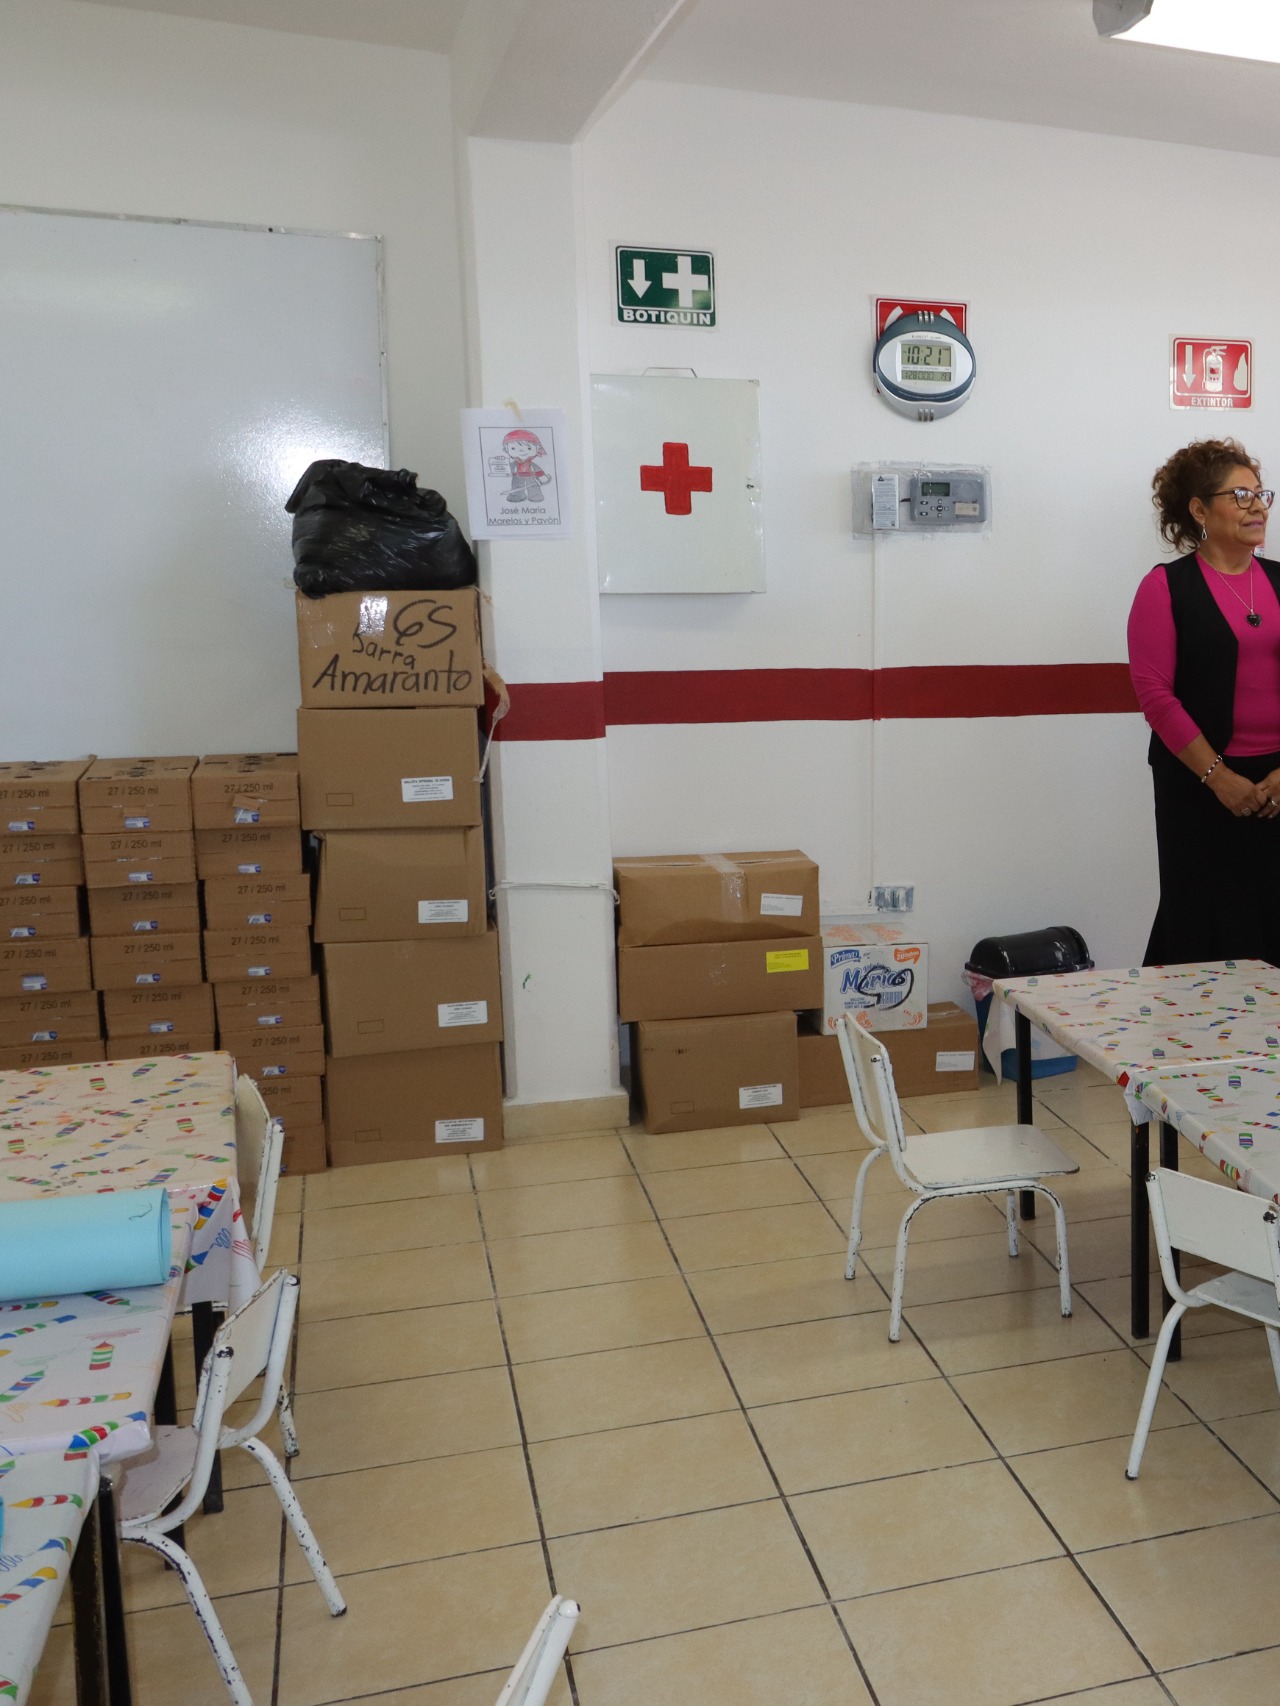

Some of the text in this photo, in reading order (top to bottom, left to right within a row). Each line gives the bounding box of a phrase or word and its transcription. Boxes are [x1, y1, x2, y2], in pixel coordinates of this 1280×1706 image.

[622, 308, 711, 325] BOTIQUIN
[907, 345, 942, 365] 10:21
[1191, 397, 1234, 408] EXTINTOR
[500, 506, 546, 515] José María
[532, 517, 559, 525] Pavón
[312, 650, 472, 695] Amaranto
[18, 789, 35, 798] 250
[38, 788, 50, 797] ml
[107, 787, 119, 795] 27
[128, 786, 144, 795] 250
[147, 786, 159, 794] ml
[225, 785, 235, 793] 27
[243, 783, 260, 793] 250
[263, 783, 274, 791] ml
[222, 834, 233, 843] 27
[241, 833, 257, 842] 250
[2, 845, 13, 853] 27
[23, 843, 39, 852] 250
[43, 842, 55, 851] ml
[111, 841, 122, 849] 27
[131, 840, 148, 848] 250
[150, 839, 162, 847] ml
[238, 886, 248, 894] 27
[257, 884, 273, 894] 250
[275, 883, 286, 892] ml
[20, 896, 36, 905] 250
[40, 895, 50, 904] ml
[122, 892, 133, 901] 27
[142, 891, 159, 900] 250
[231, 937, 242, 945] 27
[250, 936, 266, 944] 250
[269, 935, 279, 943] ml
[124, 945, 135, 953] 27
[144, 944, 160, 952] 250
[163, 943, 174, 951] ml
[4, 951, 14, 959] 27
[25, 950, 42, 958] 250
[45, 949, 56, 957] ml
[242, 986, 252, 995] 27
[261, 985, 277, 994] 250
[279, 985, 290, 993] ml
[132, 995, 143, 1003] 27
[152, 993, 168, 1002] 250
[171, 992, 182, 1000] ml
[20, 1003, 31, 1011] 27
[40, 1000, 57, 1009] 250
[60, 1000, 72, 1008] ml
[252, 1038, 263, 1047] 27
[271, 1037, 287, 1045] 250
[289, 1036, 300, 1044] ml
[140, 1046, 151, 1054] 27
[159, 1044, 176, 1052] 250
[178, 1042, 189, 1051] ml
[21, 1054, 31, 1062] 27
[42, 1052, 58, 1060] 250
[61, 1051, 72, 1059] ml
[263, 1086, 291, 1096] 250 ml
